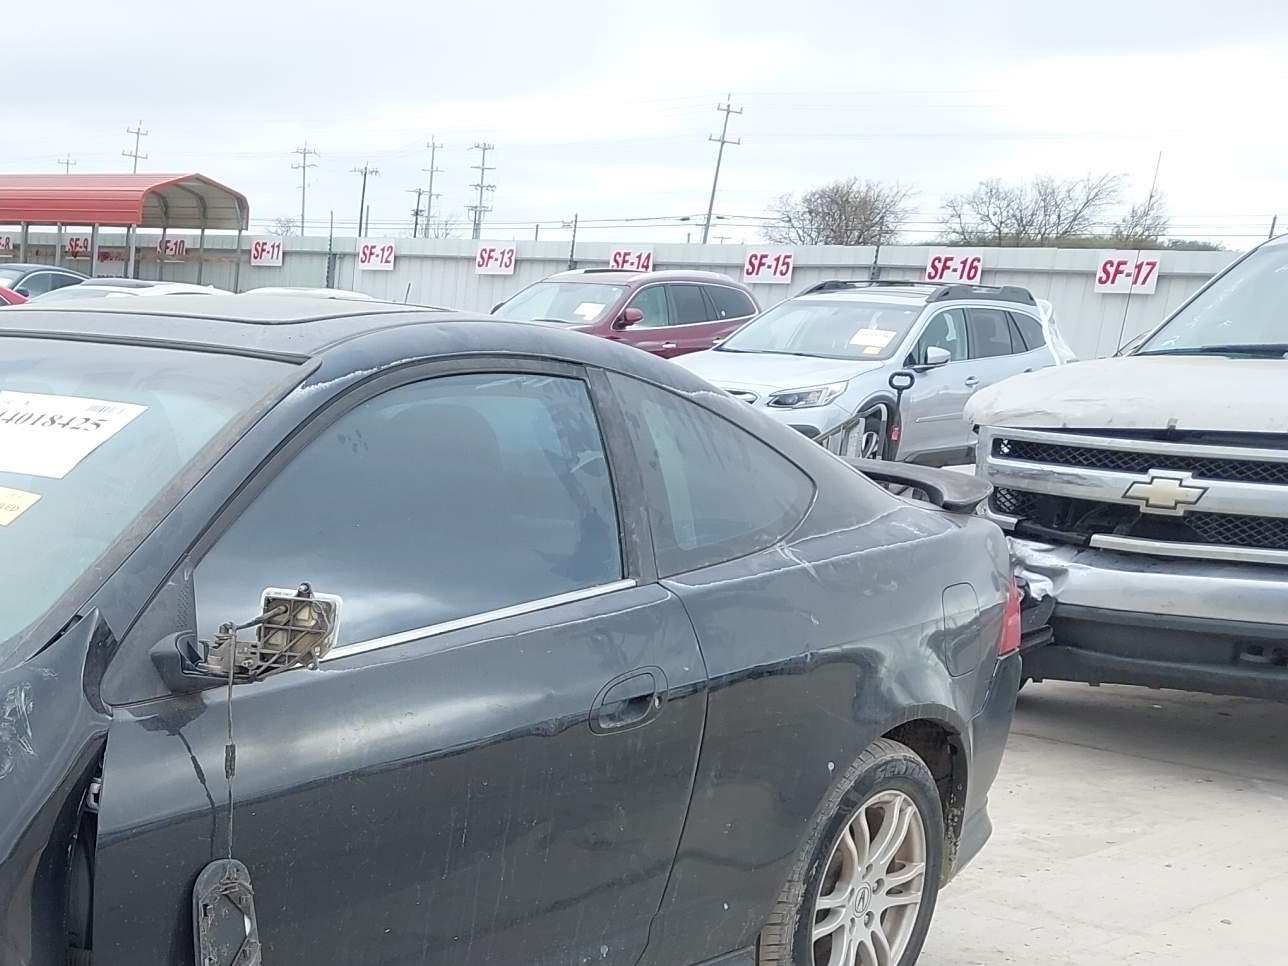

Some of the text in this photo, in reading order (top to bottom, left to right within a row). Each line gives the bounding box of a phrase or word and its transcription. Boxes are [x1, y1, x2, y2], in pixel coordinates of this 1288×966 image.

[253, 241, 281, 261] SF-11
[361, 245, 394, 264] SF-12
[477, 248, 513, 269] SF-13
[612, 251, 652, 272] SF-14
[746, 253, 792, 276] SF-15
[927, 256, 982, 281] SF-16
[1098, 259, 1158, 286] SF-17
